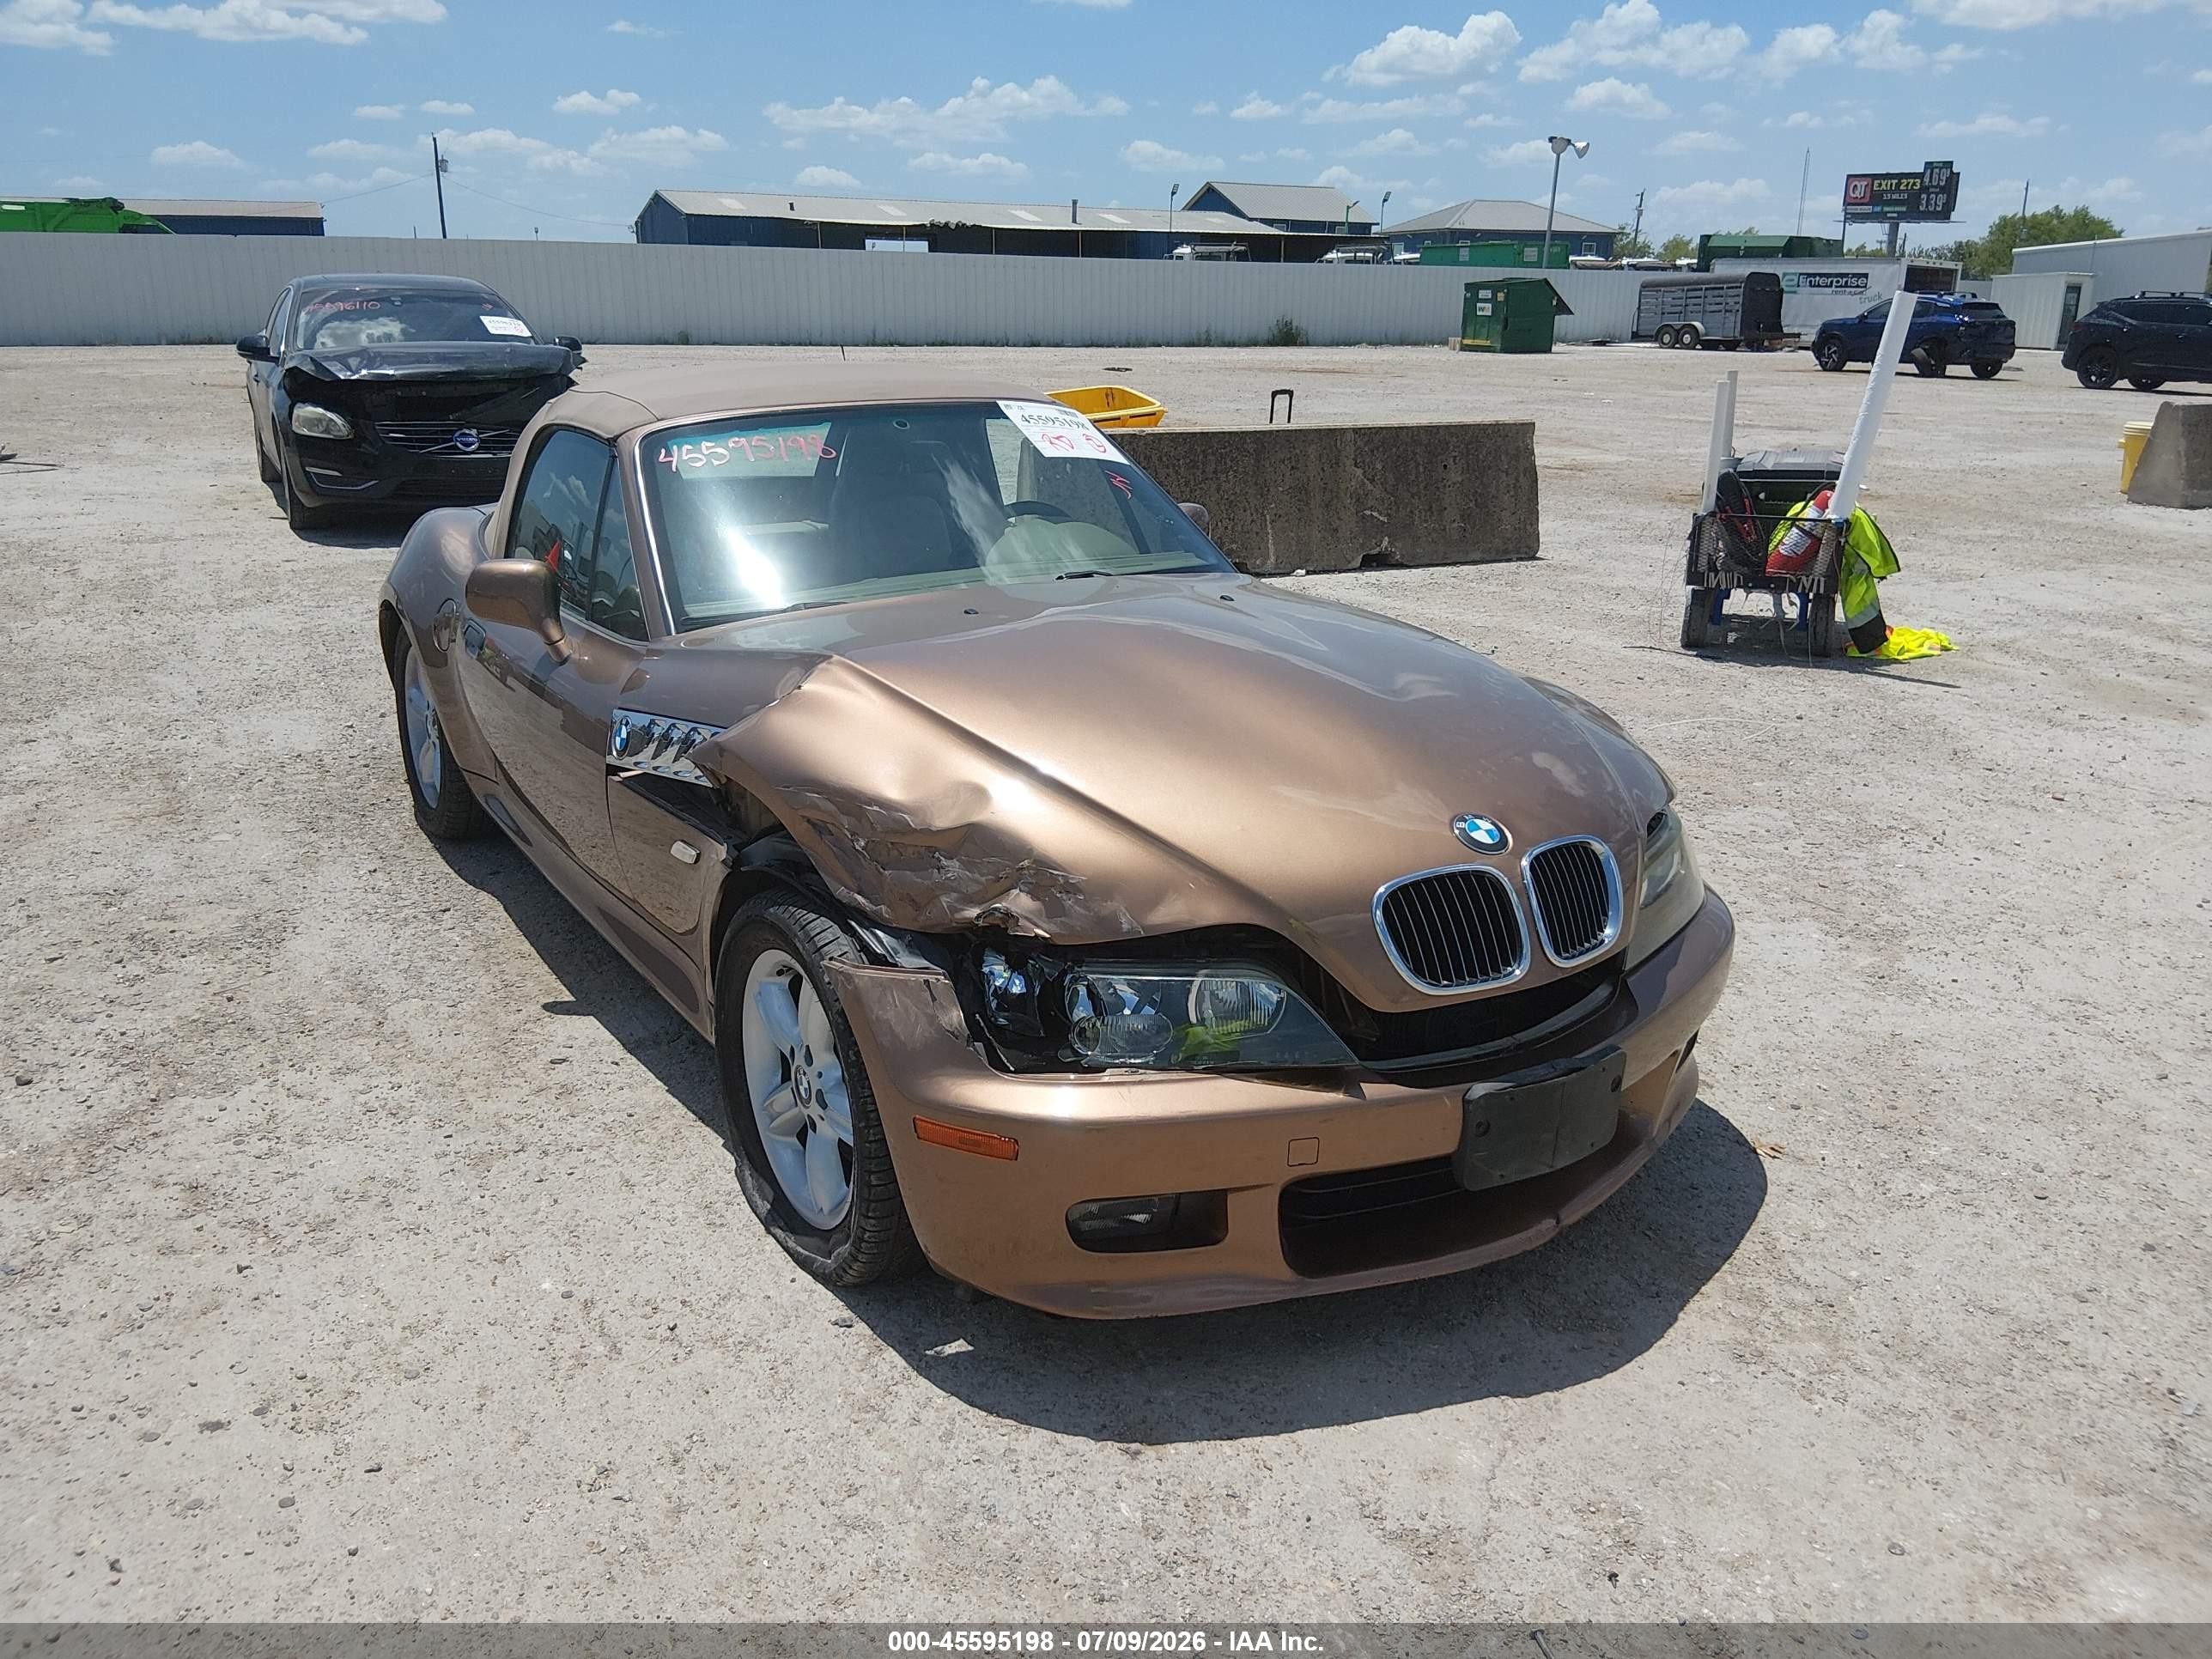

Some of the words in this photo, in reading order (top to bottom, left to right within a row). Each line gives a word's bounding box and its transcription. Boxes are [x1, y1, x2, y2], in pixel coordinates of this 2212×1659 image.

[1849, 181, 1868, 199] QT
[1873, 179, 1898, 191] EXIT
[1899, 178, 1921, 190] 273
[1799, 275, 1867, 289] Enterprise
[1859, 291, 1883, 304] truck
[1020, 414, 1090, 431] 45595198
[659, 434, 837, 472] 45595198
[1455, 814, 1492, 829] BMW
